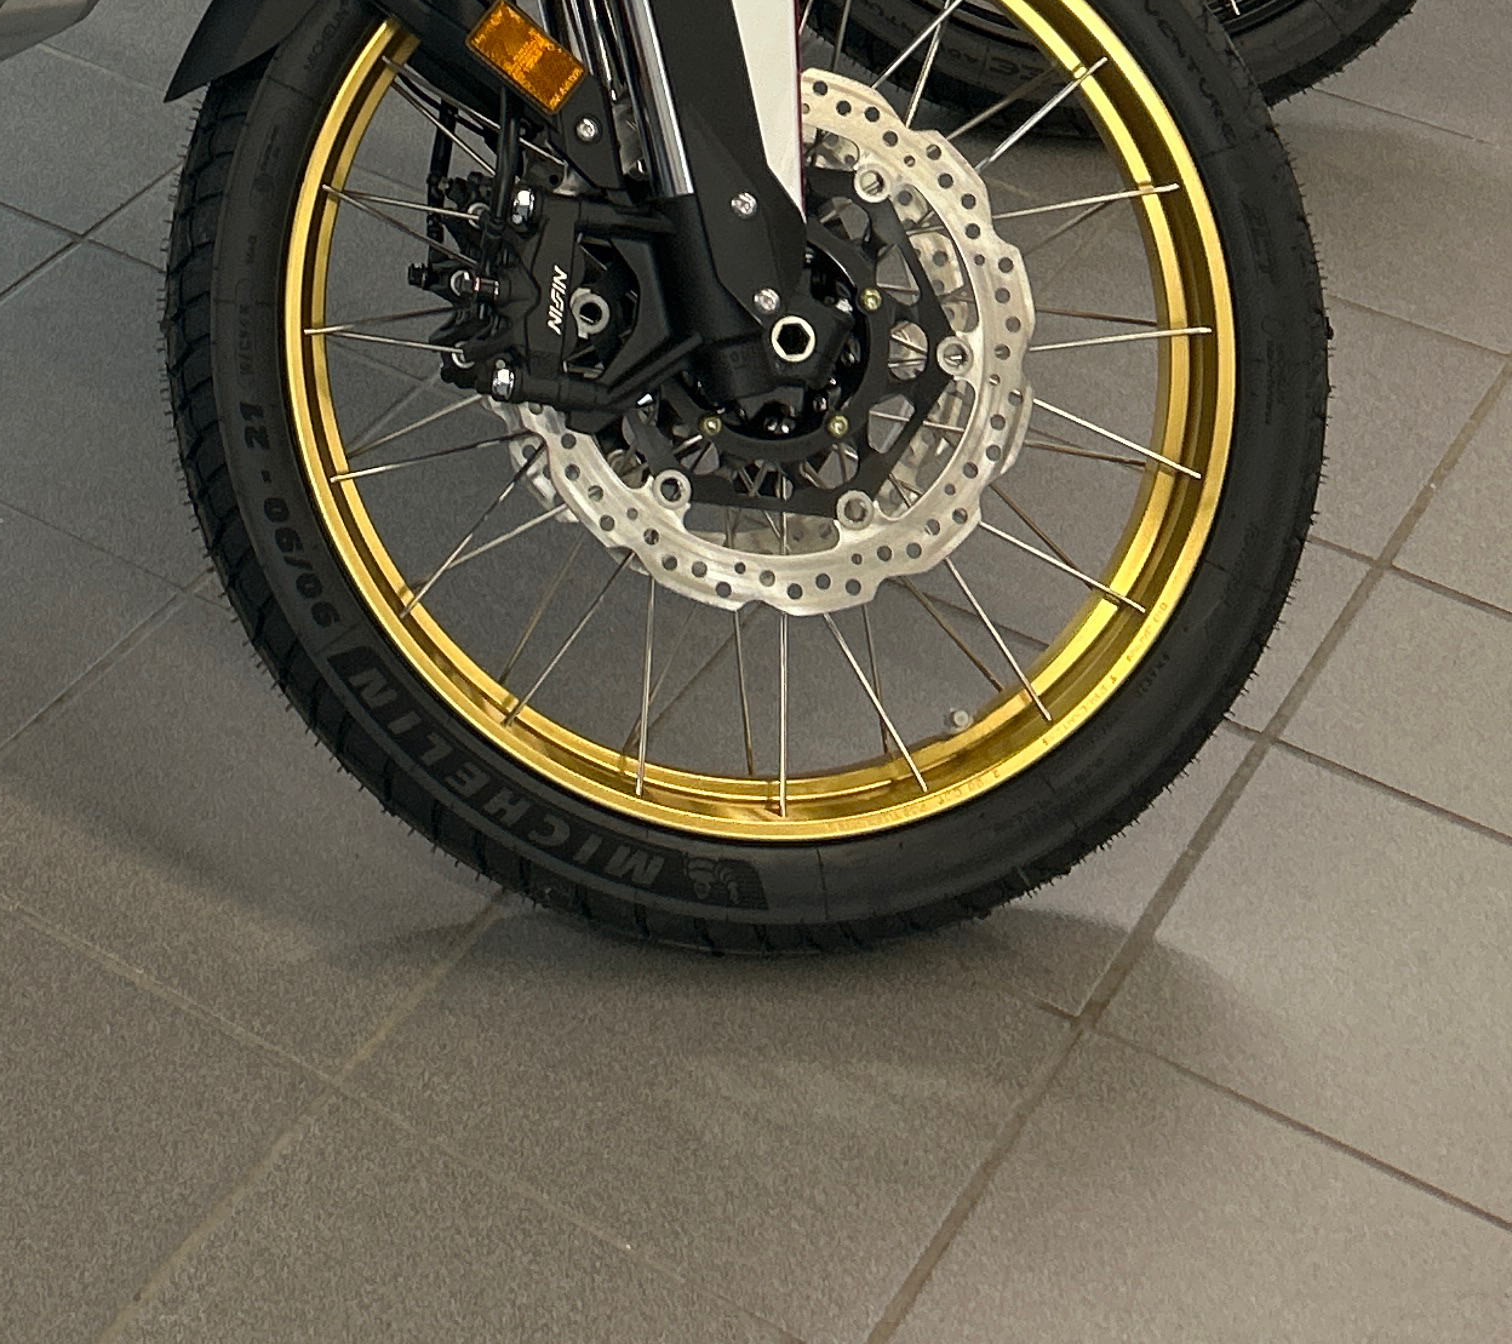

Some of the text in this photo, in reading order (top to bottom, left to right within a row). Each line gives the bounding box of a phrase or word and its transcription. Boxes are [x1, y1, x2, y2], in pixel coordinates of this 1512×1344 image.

[240, 401, 271, 453] 21
[261, 494, 342, 630] 90/90
[346, 668, 666, 889] MICHELIN
